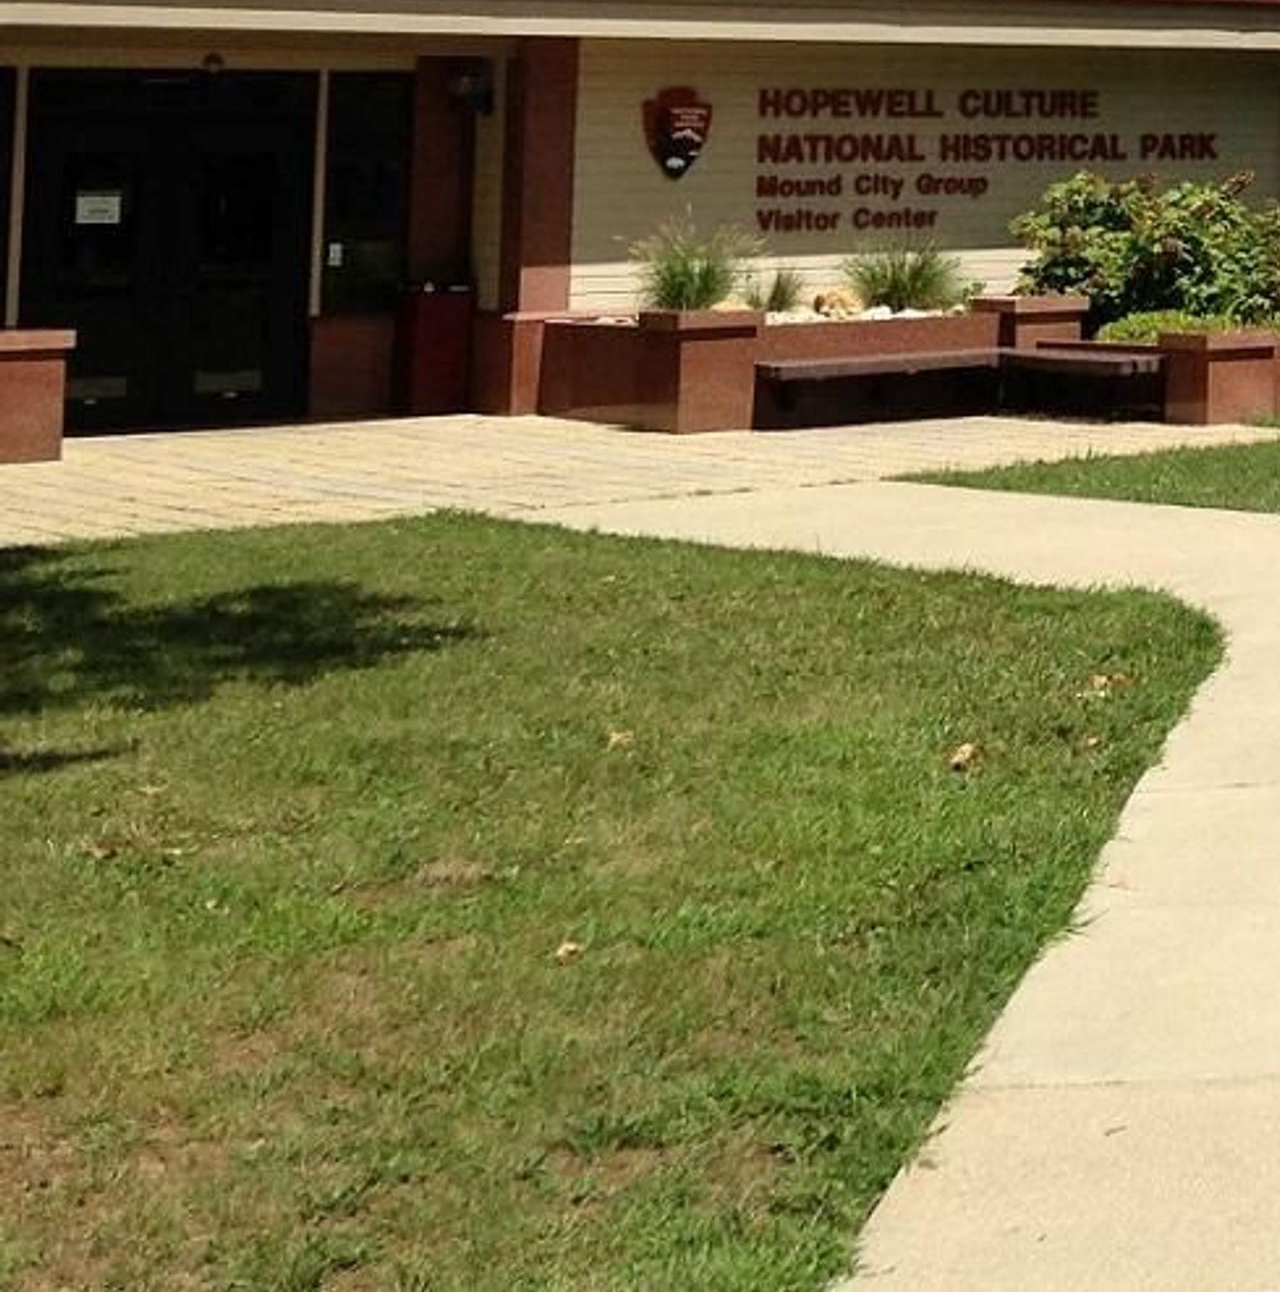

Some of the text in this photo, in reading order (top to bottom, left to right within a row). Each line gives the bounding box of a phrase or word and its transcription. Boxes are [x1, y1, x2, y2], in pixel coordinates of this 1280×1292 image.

[758, 89, 1100, 118] HOPEWELL CULTURE
[757, 132, 1218, 163] NATIONAL HISTORICAL PARK
[756, 172, 988, 200] Mound City Group
[756, 208, 938, 231] Visitor Center
